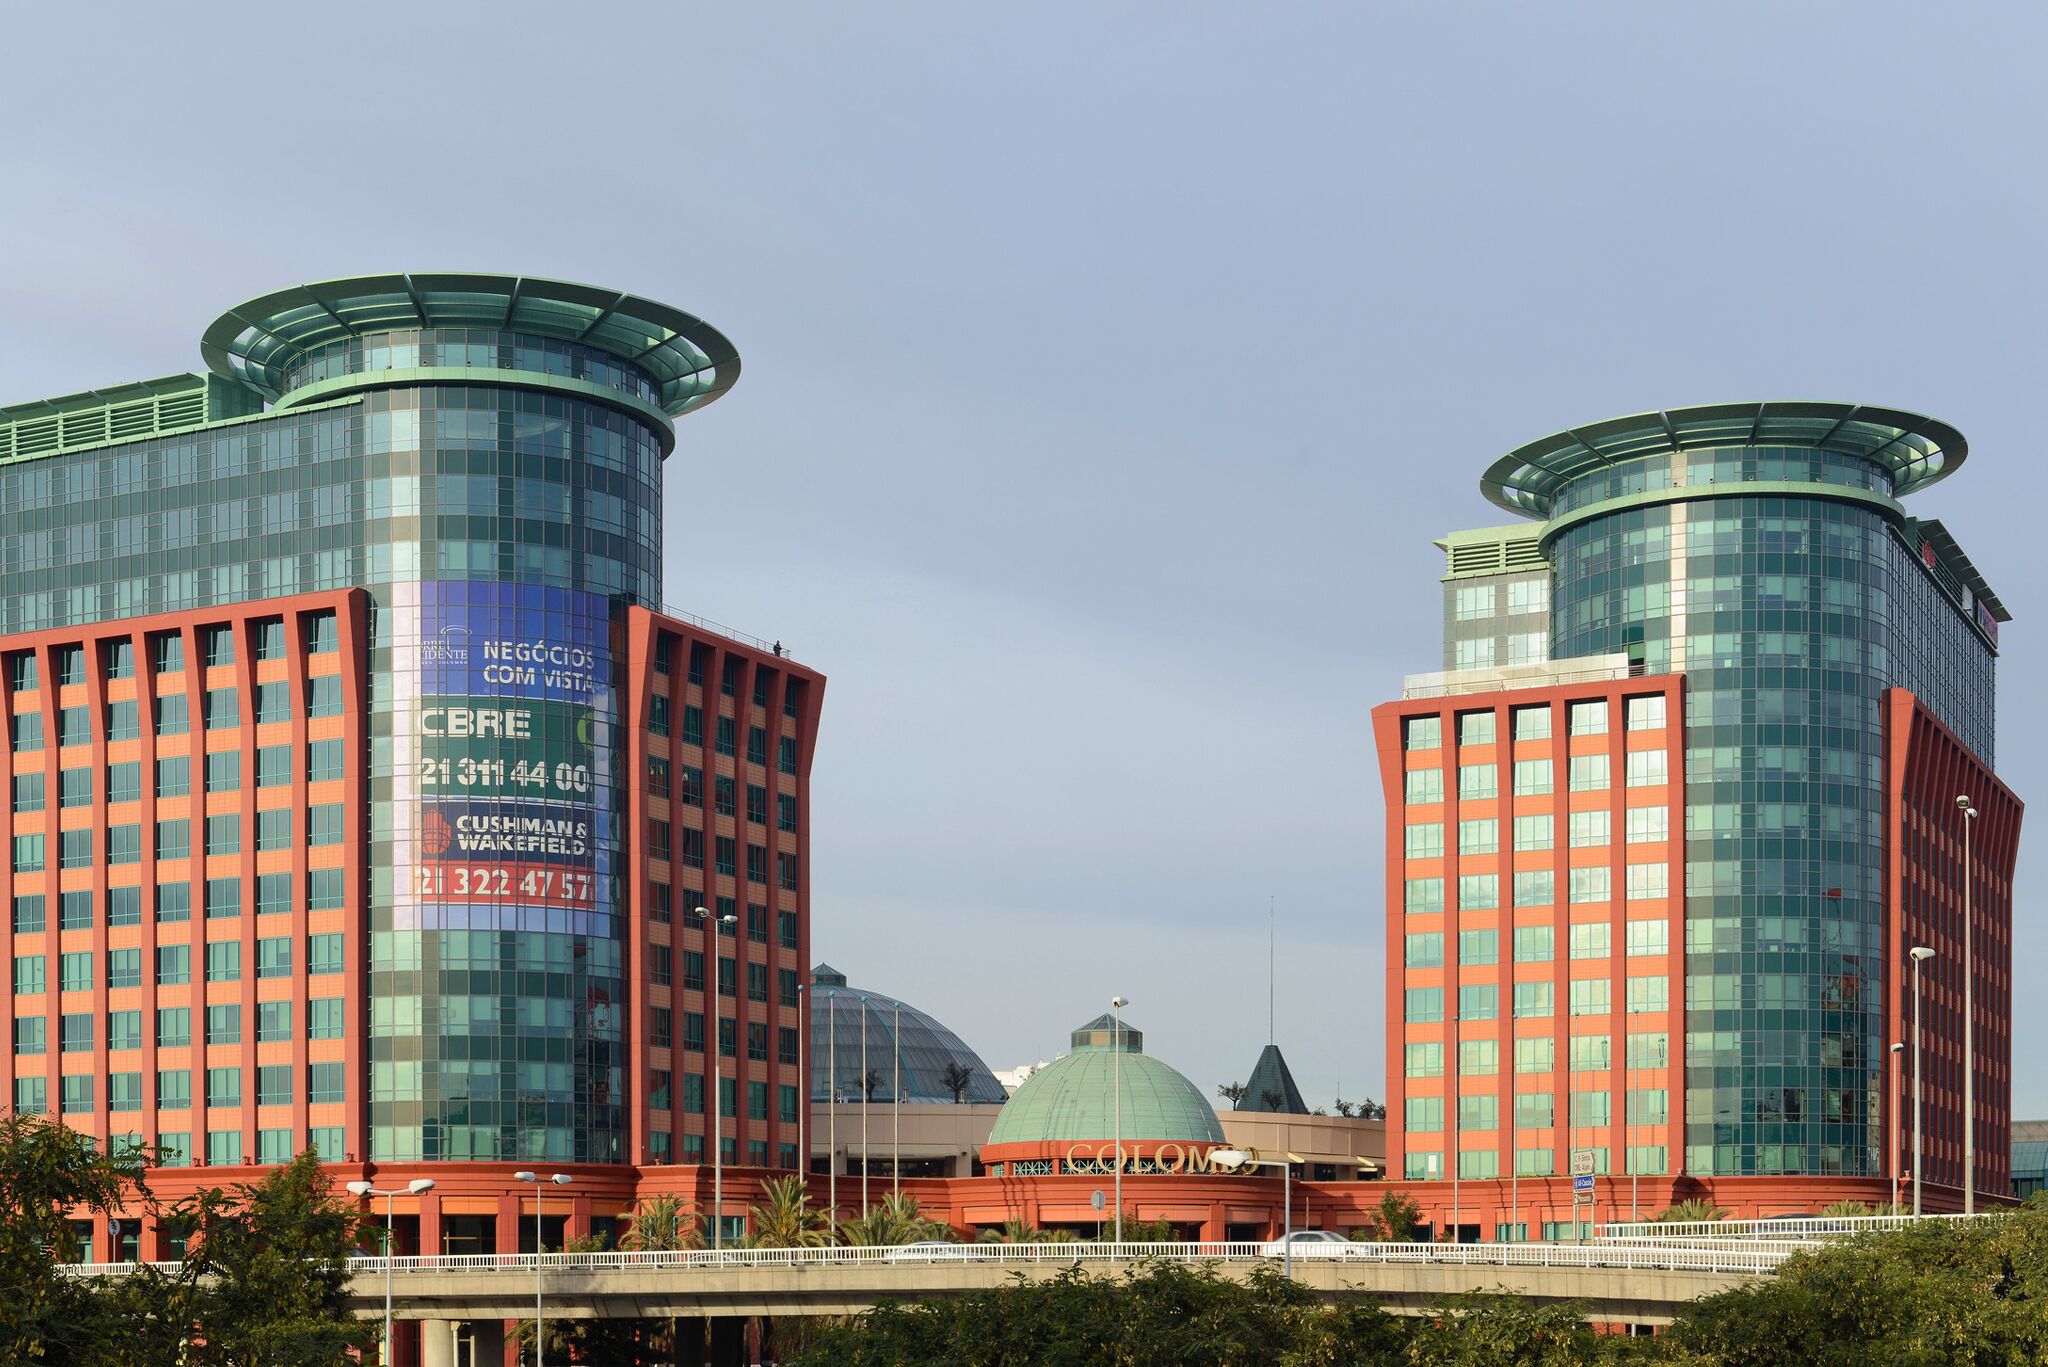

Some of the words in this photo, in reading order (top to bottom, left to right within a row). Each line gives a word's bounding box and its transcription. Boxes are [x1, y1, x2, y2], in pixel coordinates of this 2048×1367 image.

[484, 640, 594, 670] NEGÓCIOS
[483, 664, 535, 686] COM
[542, 668, 595, 694] VISTA
[417, 708, 531, 739] CBRE
[418, 757, 450, 785] 21
[457, 757, 504, 786] 311
[510, 759, 549, 788] 44
[555, 762, 590, 793] 00
[456, 815, 572, 837] CUSHMAN
[575, 822, 588, 839] &
[457, 833, 586, 855] WAKEFIELD
[416, 868, 443, 894] 21
[454, 868, 511, 896] 322
[519, 870, 553, 897] 47
[561, 872, 591, 900] 57
